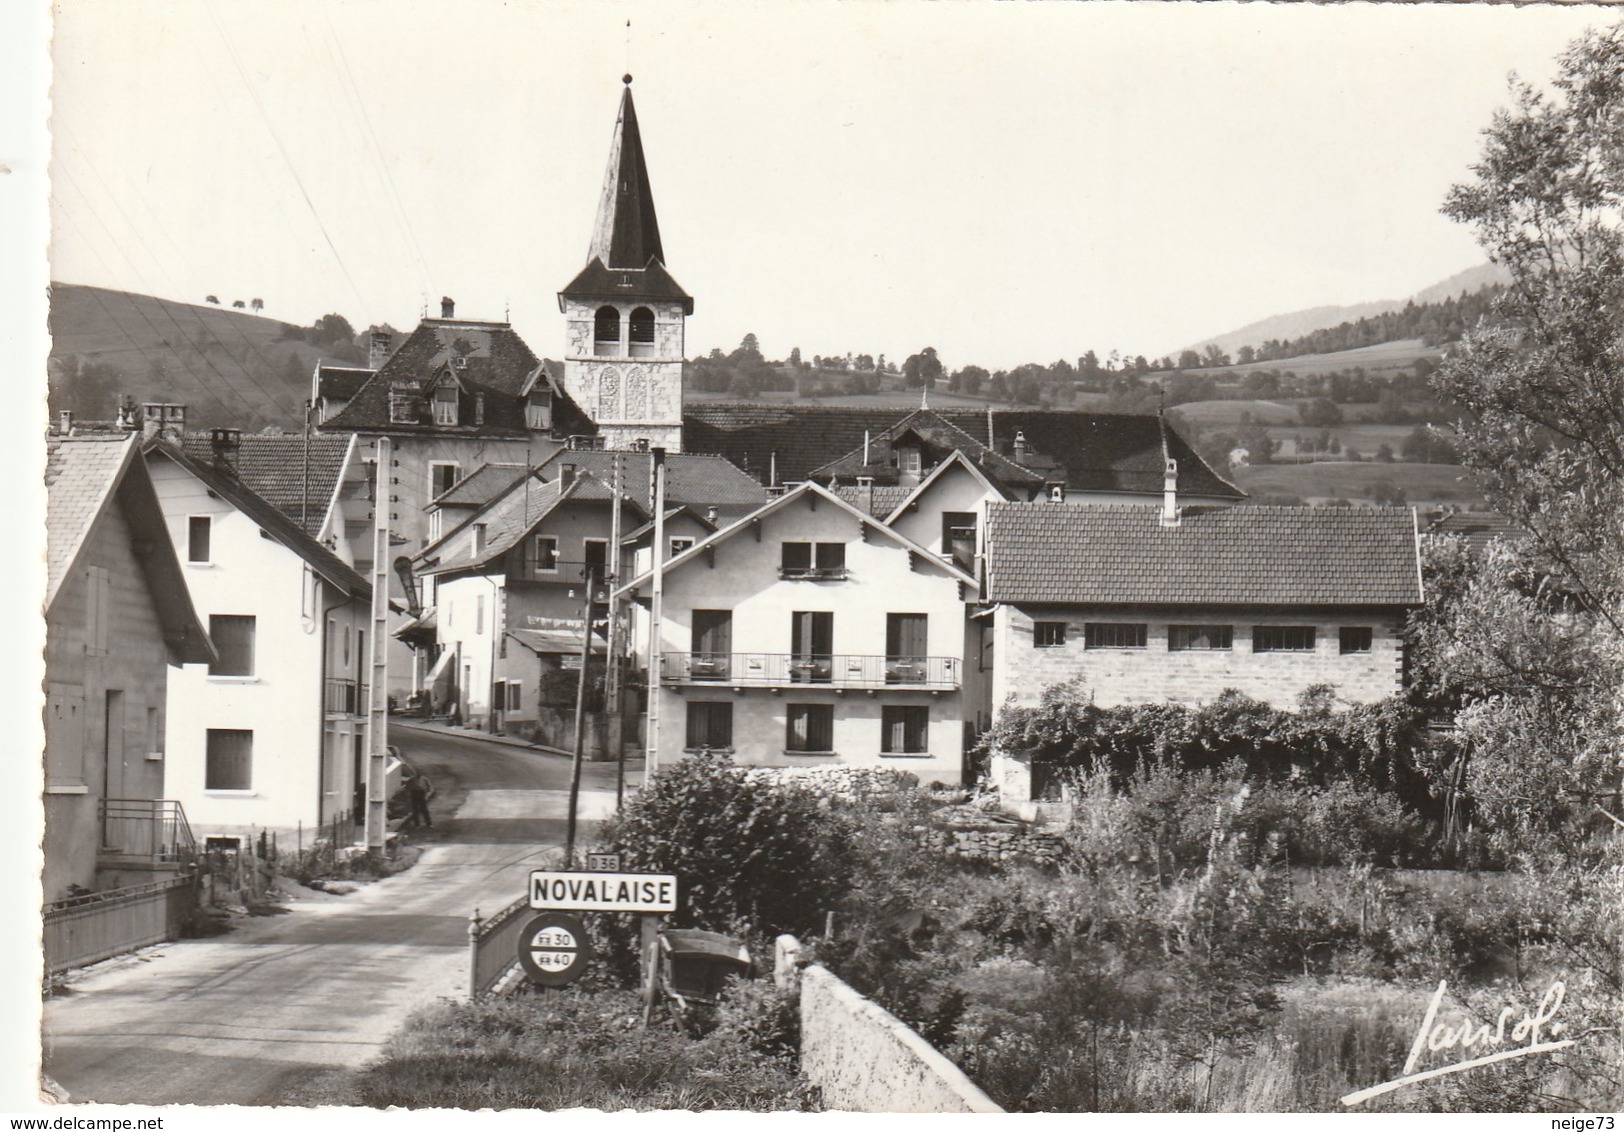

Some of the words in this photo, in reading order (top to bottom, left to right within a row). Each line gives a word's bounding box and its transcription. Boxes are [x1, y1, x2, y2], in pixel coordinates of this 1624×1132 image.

[591, 857, 598, 869] D
[600, 857, 616, 869] 36
[534, 879, 671, 904] NOVALAISE
[554, 934, 570, 945] 30
[553, 954, 570, 965] 40
